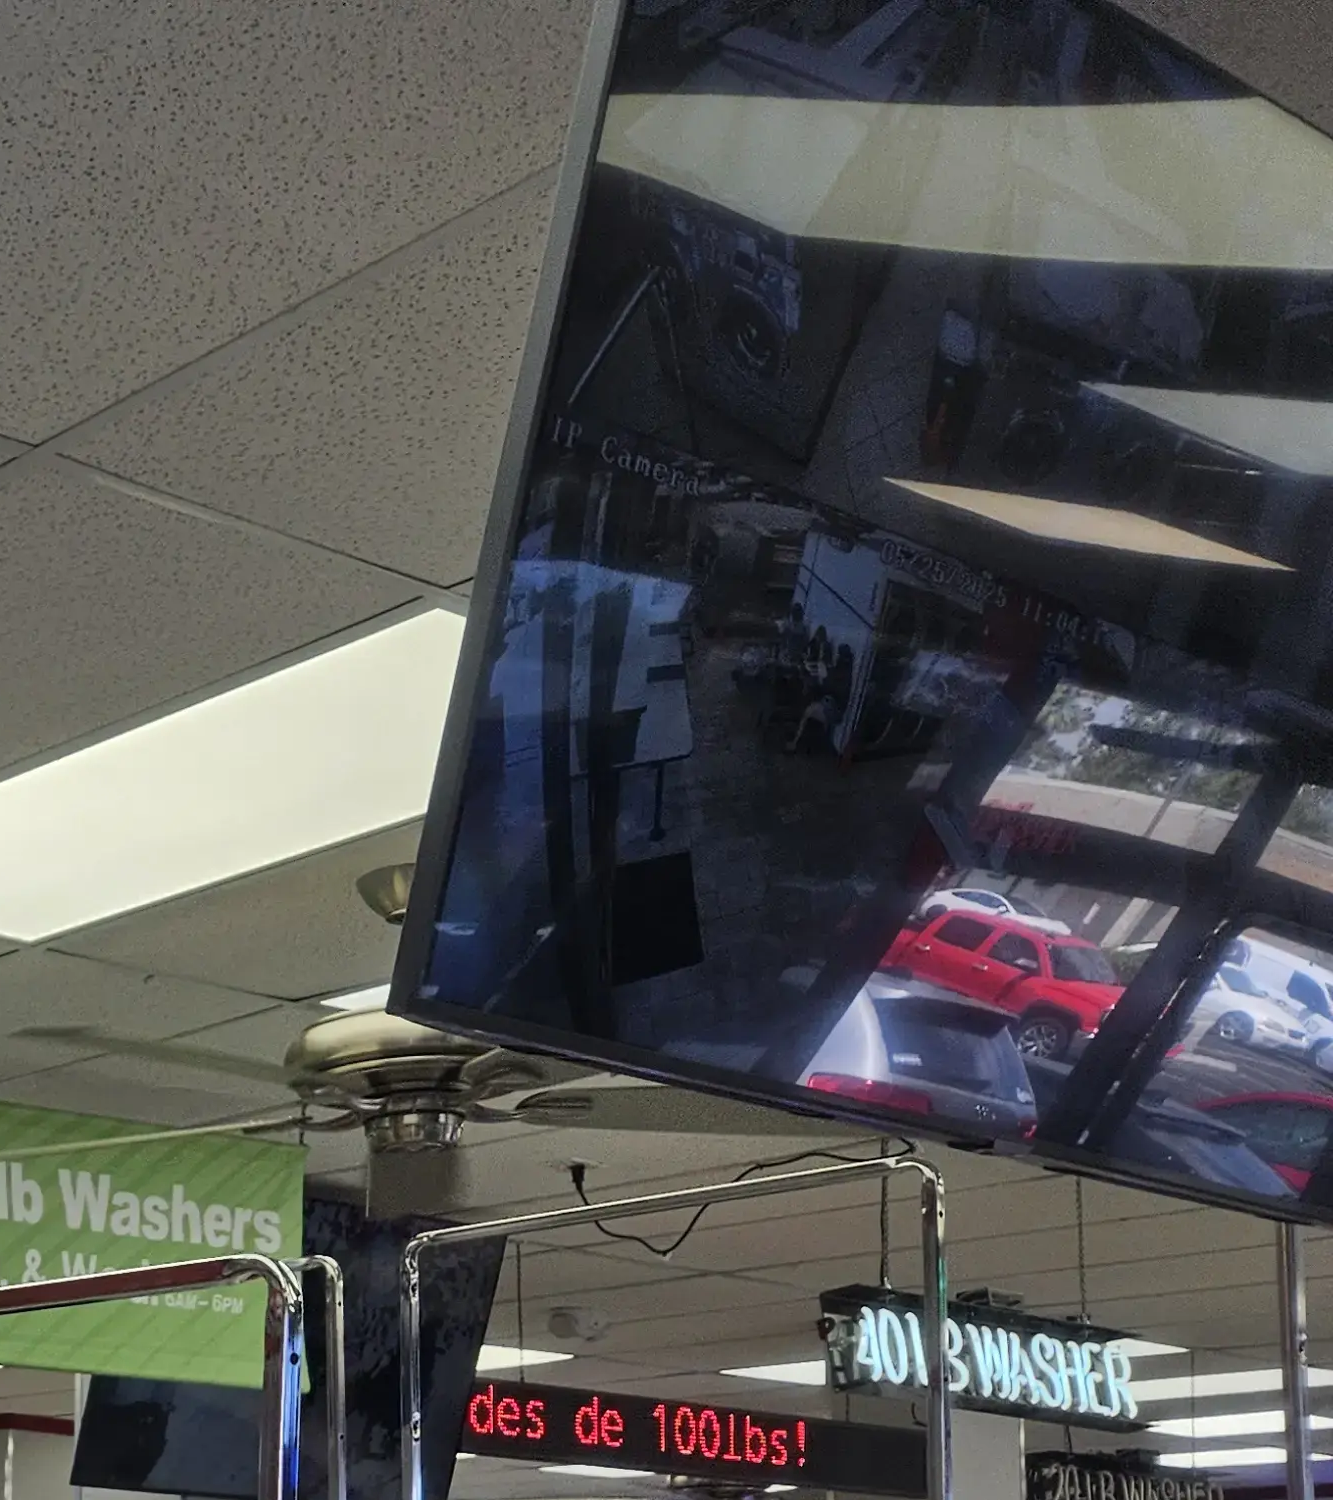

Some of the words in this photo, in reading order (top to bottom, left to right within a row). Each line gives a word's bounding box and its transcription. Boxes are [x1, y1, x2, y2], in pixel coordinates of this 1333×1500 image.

[600, 436, 700, 496] Camera
[58, 1168, 283, 1254] Washers
[965, 1323, 1139, 1419] WASHER
[470, 1384, 545, 1440] des
[575, 1396, 624, 1447] de
